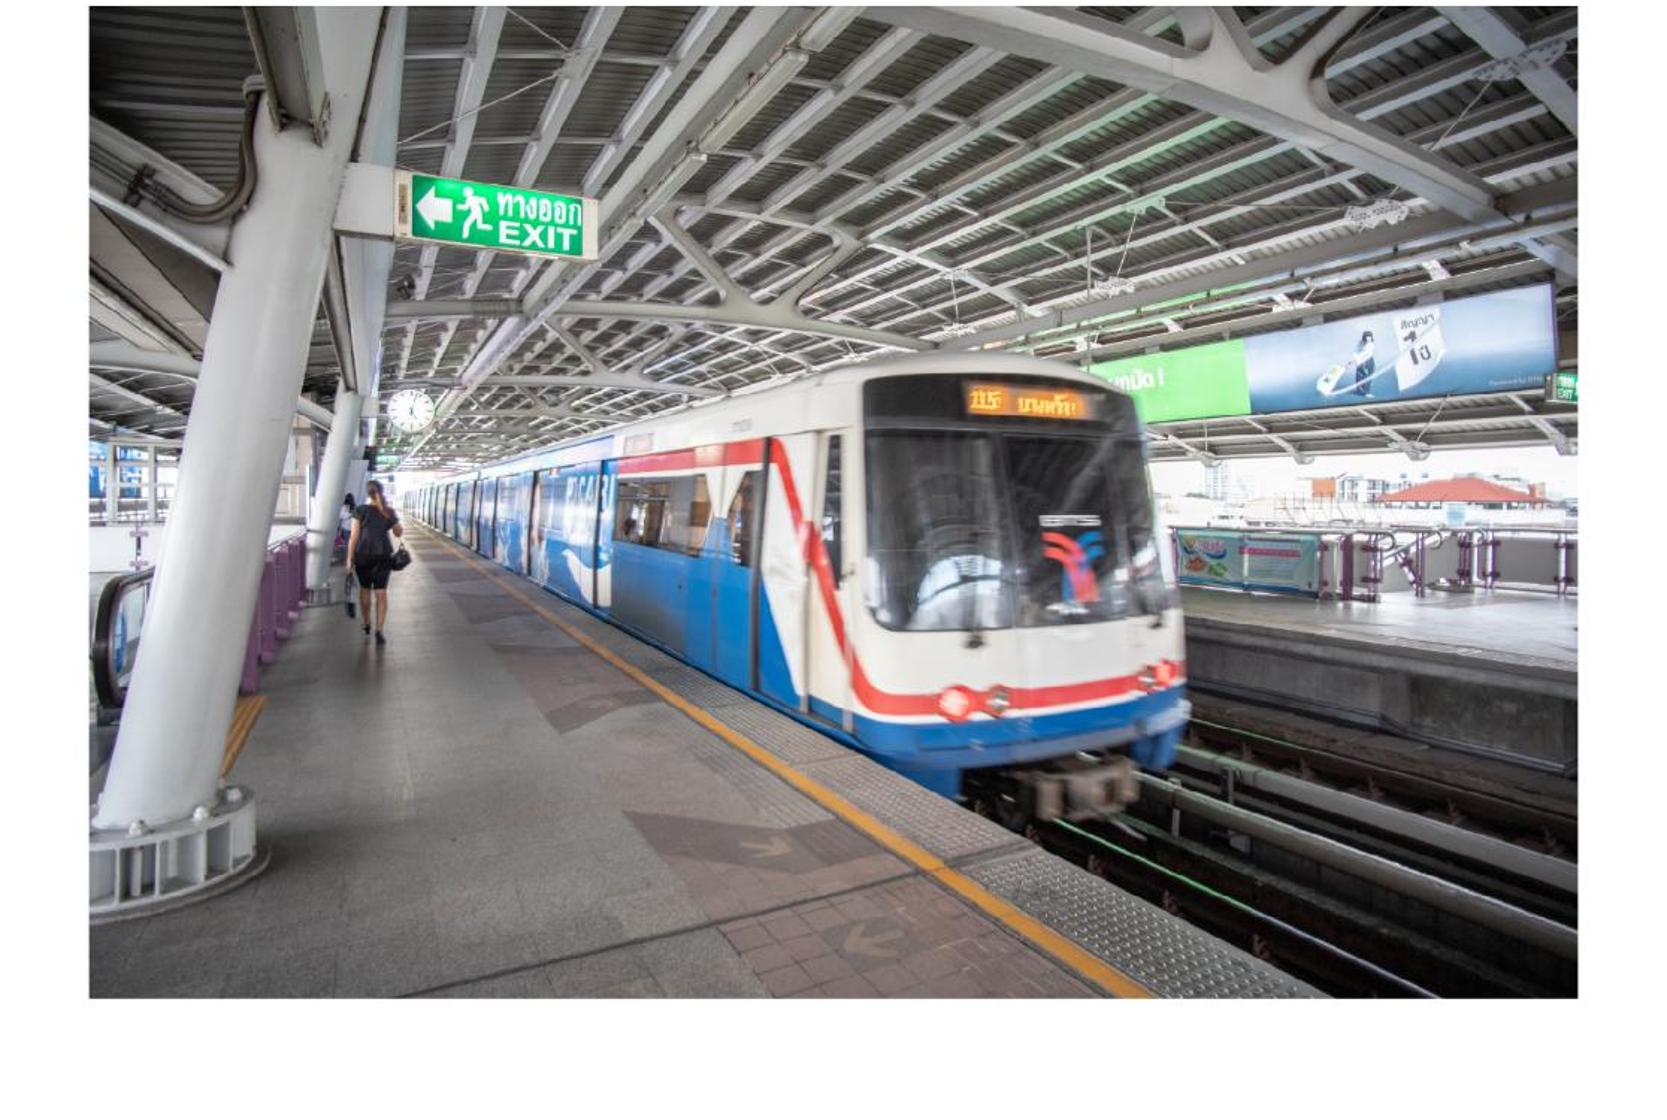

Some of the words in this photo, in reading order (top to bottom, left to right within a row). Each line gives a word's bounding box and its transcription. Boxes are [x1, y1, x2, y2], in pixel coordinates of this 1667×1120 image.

[497, 192, 582, 227] ทางออก
[499, 220, 578, 251] EXIT
